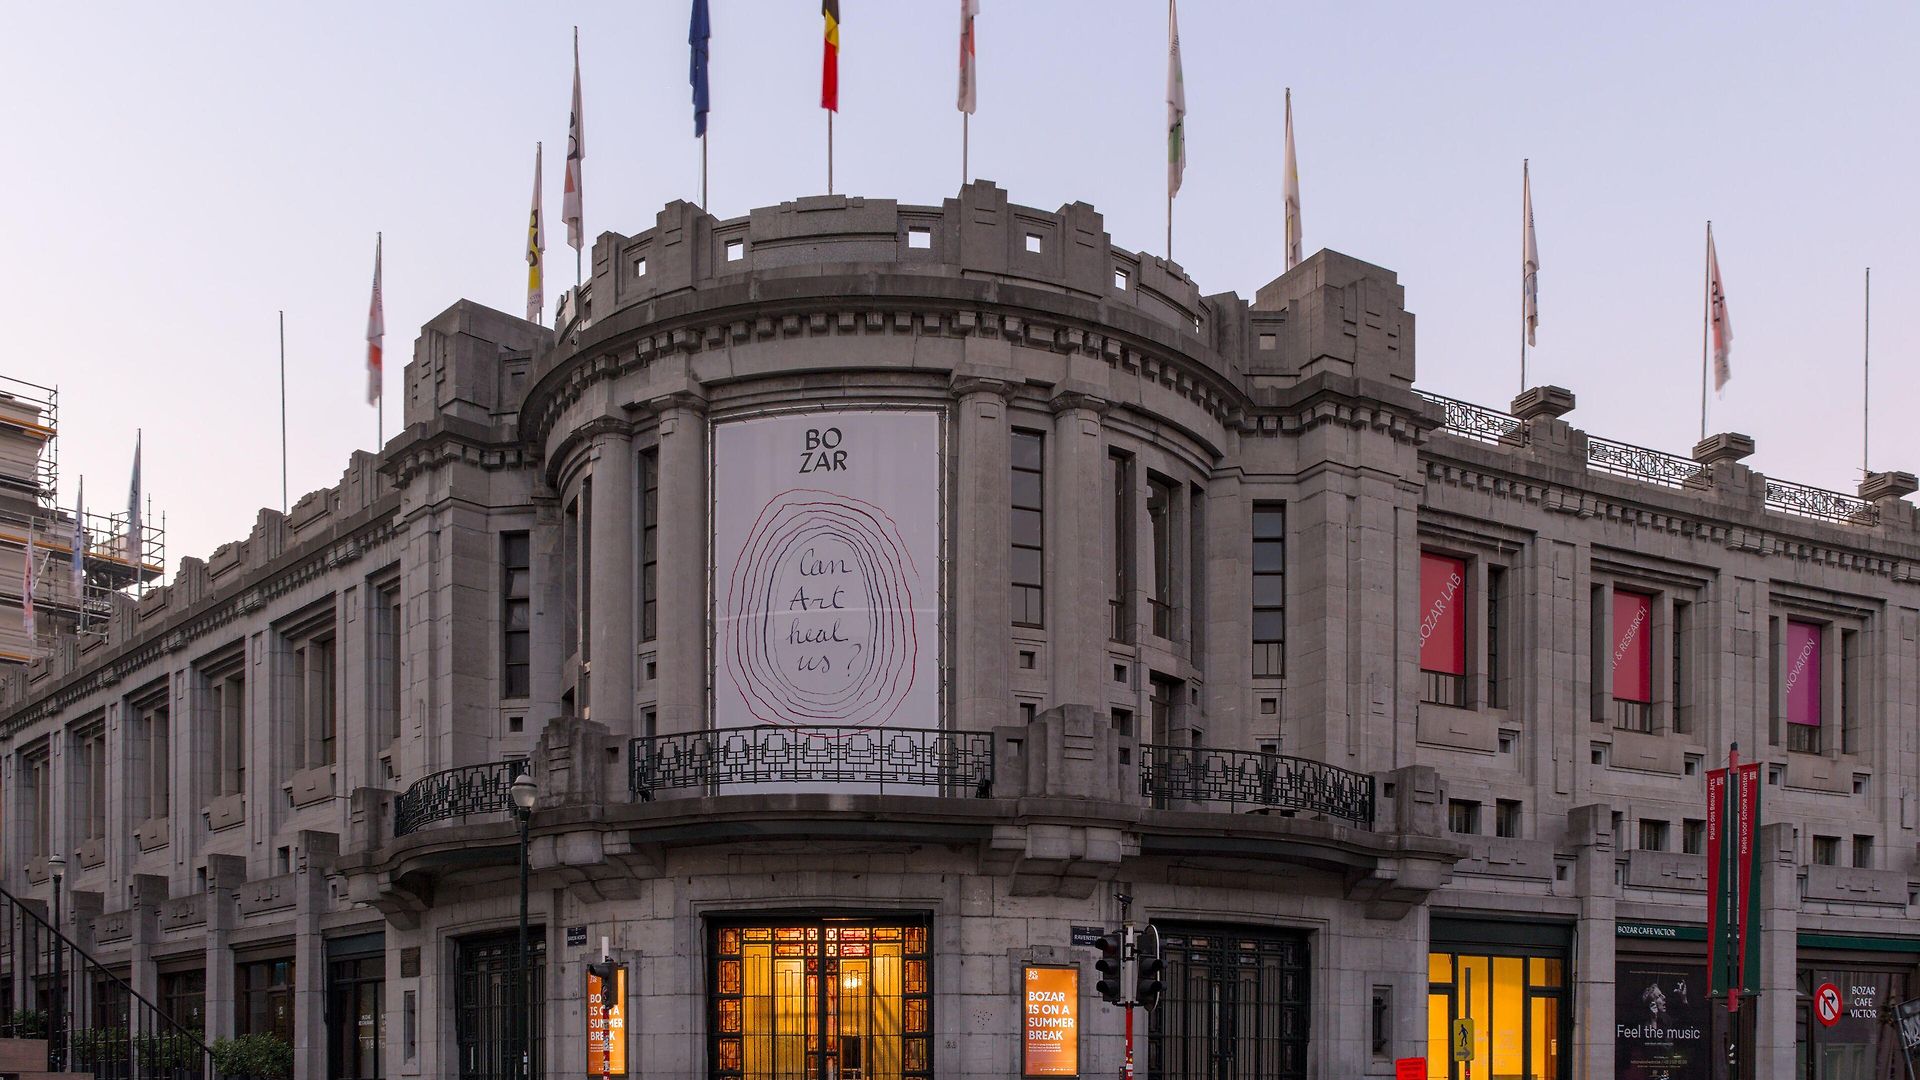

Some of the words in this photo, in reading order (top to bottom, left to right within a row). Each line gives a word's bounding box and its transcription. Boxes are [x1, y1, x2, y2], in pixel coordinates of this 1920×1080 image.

[805, 427, 842, 450] BO
[799, 450, 848, 473] ZAR
[799, 548, 852, 576] Can
[1441, 572, 1461, 601] LAB
[789, 585, 844, 610] Art
[786, 617, 848, 645] heal
[1619, 606, 1647, 652] RESEARCH
[1617, 925, 1638, 934] BOZAR
[1653, 928, 1676, 937] VICTOR
[1028, 991, 1065, 1002] BOZAR
[1851, 986, 1876, 996] BOZAR
[1854, 997, 1873, 1007] CAFE
[590, 1006, 598, 1016] IS
[613, 1004, 620, 1015] A
[1028, 1004, 1039, 1015] IS
[1042, 1004, 1059, 1015] ON
[1062, 1004, 1070, 1015] A
[1850, 1009, 1877, 1019] VICTOR
[1028, 1017, 1074, 1028] SUMMER
[590, 1031, 616, 1041] BREK
[1028, 1030, 1064, 1041] BREAK
[1617, 1024, 1641, 1038] Feel
[1644, 1025, 1663, 1039] the
[1667, 1026, 1701, 1039] music
